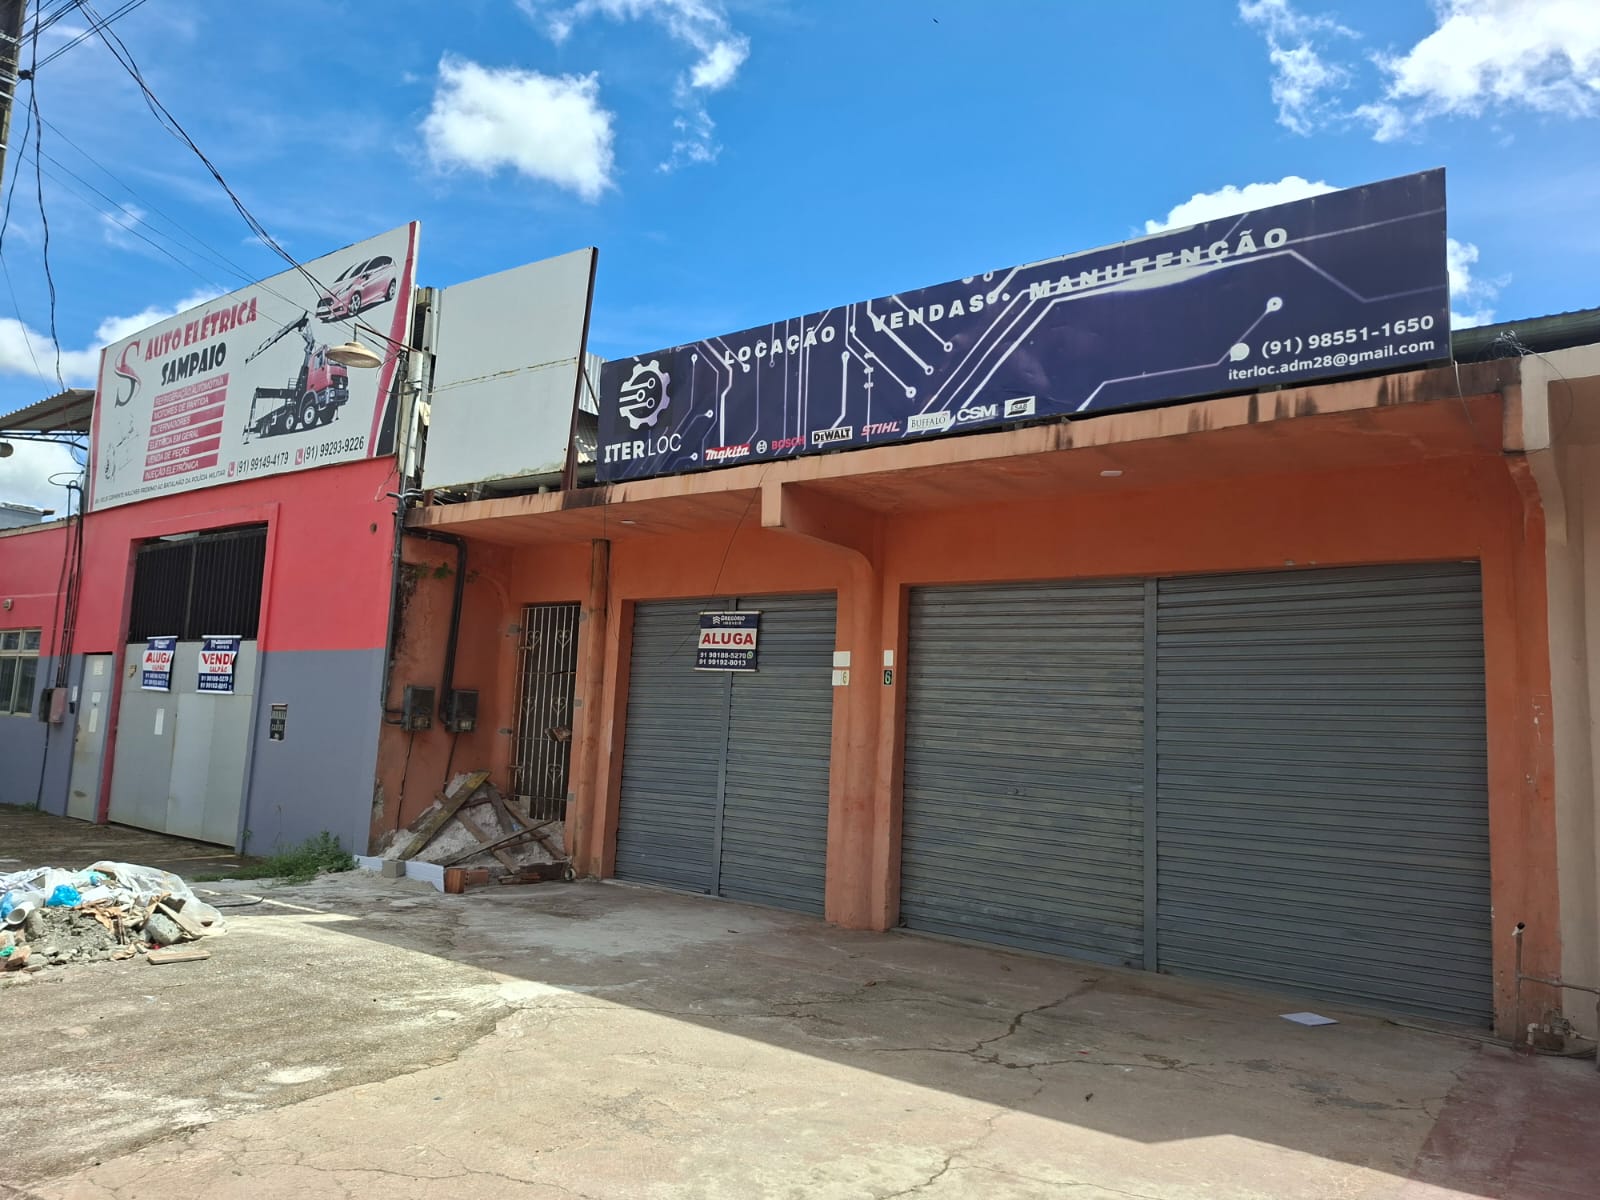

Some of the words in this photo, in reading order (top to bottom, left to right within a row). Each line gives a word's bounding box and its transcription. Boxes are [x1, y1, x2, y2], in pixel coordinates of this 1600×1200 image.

[725, 326, 836, 364] LOCAÇÃO
[873, 295, 984, 332] VENDAS
[1029, 228, 1288, 300] MANUTENÇÃO
[145, 327, 182, 362] AUTO
[184, 296, 257, 347] ELÉTRICA
[1261, 336, 1303, 359] (91)
[1308, 315, 1434, 349] 98551-1650
[161, 341, 227, 387] SAMPAIO
[1228, 340, 1435, 381] iterloc.adm28@gmail.com
[911, 416, 946, 429] BUFFALO
[957, 404, 996, 421] CSM
[861, 421, 900, 436] STIHL
[303, 445, 318, 464] (91)
[319, 435, 365, 457] 99293-9226
[604, 433, 682, 463] ITERLOC
[771, 435, 805, 450] BOSCH
[236, 458, 249, 476] (91)
[702, 632, 754, 645] ALUGA
[885, 670, 892, 685] 6
